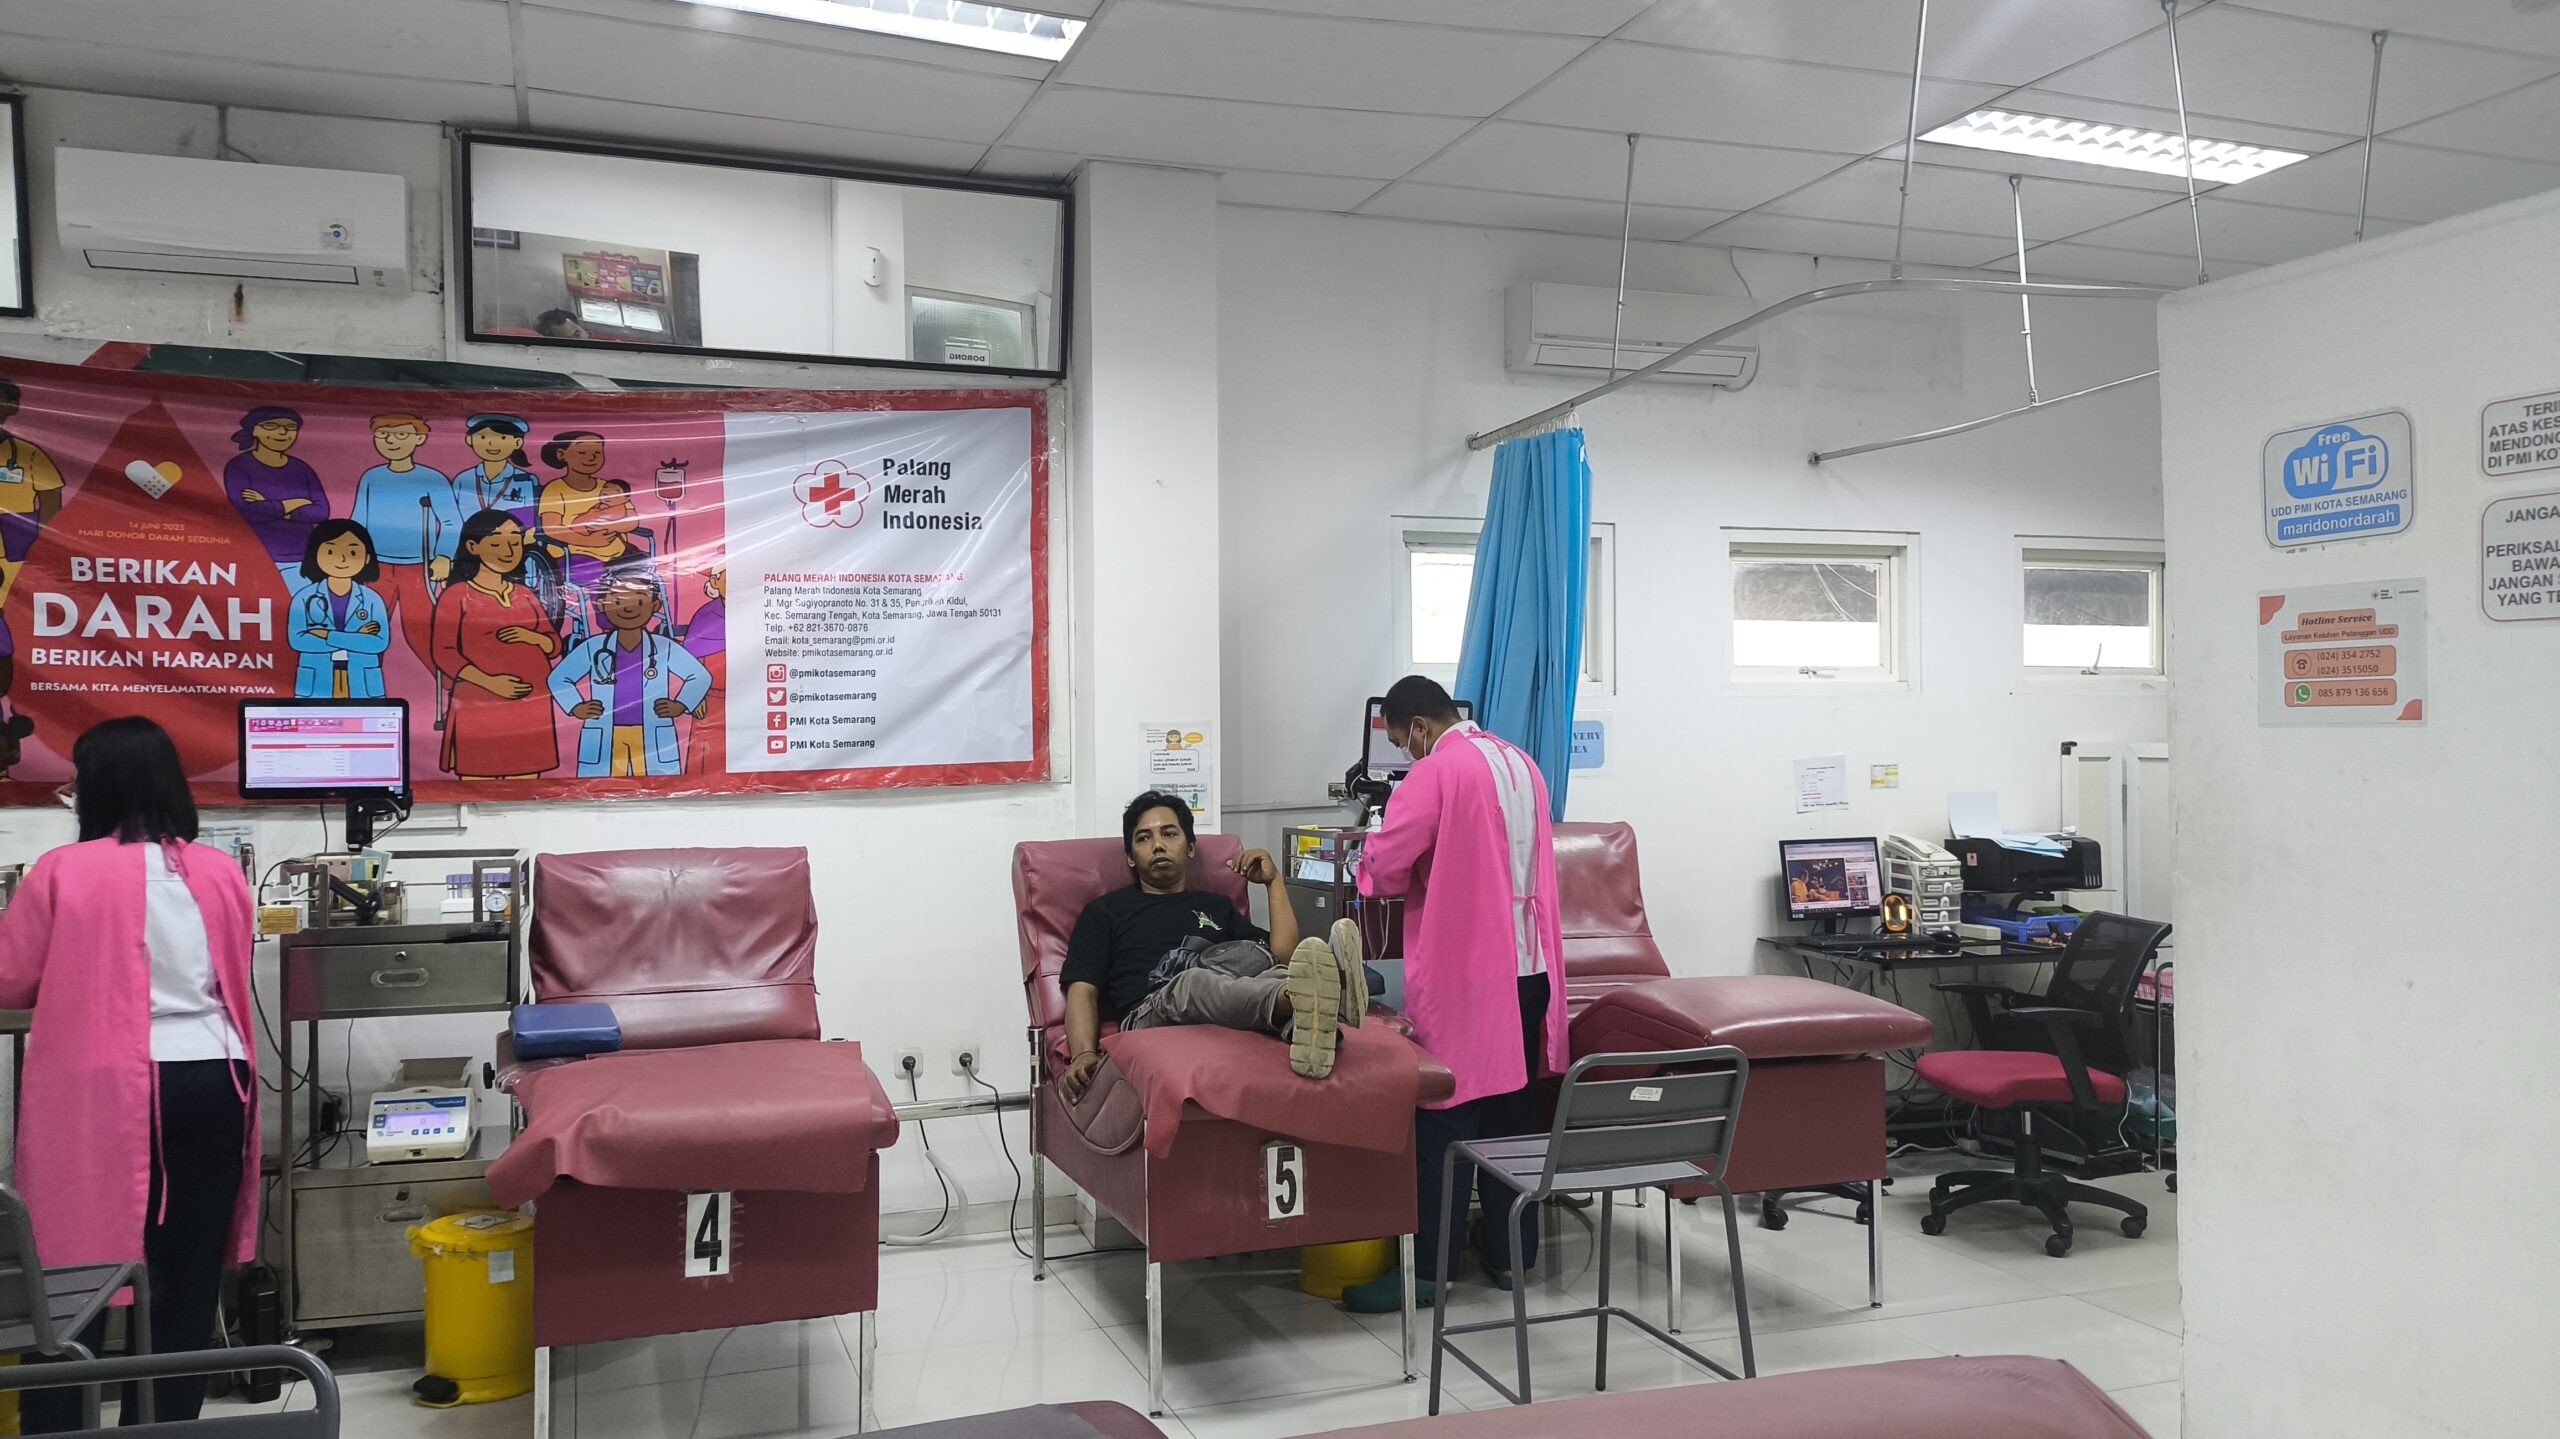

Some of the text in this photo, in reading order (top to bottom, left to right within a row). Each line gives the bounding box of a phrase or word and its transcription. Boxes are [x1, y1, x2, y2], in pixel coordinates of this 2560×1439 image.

[2523, 400, 2560, 417] TERI
[2488, 421, 2528, 438] ATAS
[2318, 430, 2350, 447] Free
[2488, 447, 2560, 468] DI PMI KO
[883, 458, 951, 479] Palang
[2292, 444, 2378, 487] Wi Fi
[883, 485, 945, 504] Merah
[2271, 488, 2408, 518] UDD PMI KOTA SEMARANG
[163, 523, 185, 531] 2025
[883, 511, 983, 530] Indonesia
[2283, 510, 2395, 536] maridonordarah
[78, 529, 231, 544] HARI DONOR DARAH SEDUNIA
[70, 556, 236, 586] BERIKAN
[764, 574, 800, 583] PALANG
[839, 574, 886, 583] INDONESIA
[888, 574, 912, 583] KOTA
[2488, 574, 2553, 591] JANGAN
[764, 586, 922, 597] Palang Merah Indonesia Kota Semarang
[2497, 591, 2542, 607] YANG
[776, 599, 793, 609] Mgr
[796, 599, 853, 609] Sugiyopranoto
[855, 599, 868, 608] No.
[871, 599, 880, 607] 31
[882, 599, 888, 607] &
[890, 599, 903, 609] 35,
[946, 597, 968, 606] Kidul,
[32, 592, 272, 641] DARAH
[764, 611, 783, 620] Kec.
[785, 611, 826, 621] Semarang
[829, 611, 860, 621] Tengah,
[862, 611, 880, 620] Kota
[926, 610, 947, 618] Jawa
[949, 608, 977, 619] Tengah
[980, 608, 1001, 617] 50131
[2301, 613, 2373, 627] Hotline Service
[765, 623, 868, 633] Telp. +62 821-3670-0876
[765, 635, 895, 646] Email: kota_semarang@pmi.or.id
[31, 648, 273, 669] BERIKAN HARAPAN
[765, 647, 893, 658] Website: pmikotasemarang.or.id
[2317, 649, 2381, 662] (024) 354 2752
[789, 667, 876, 679] @pmikotasemarang
[2317, 665, 2379, 676] (024) 3515050
[30, 682, 275, 694] BERSAMA KITA MENYELAMATKAN NYAWA
[2318, 688, 2389, 697] 085 879 136 656
[789, 691, 877, 703] @pmikotasemarang
[789, 714, 876, 726] PMI Kota Semarang
[790, 738, 875, 750] PMI Kota Semarang
[1275, 1147, 1296, 1215] 5
[694, 1193, 722, 1272] 4
